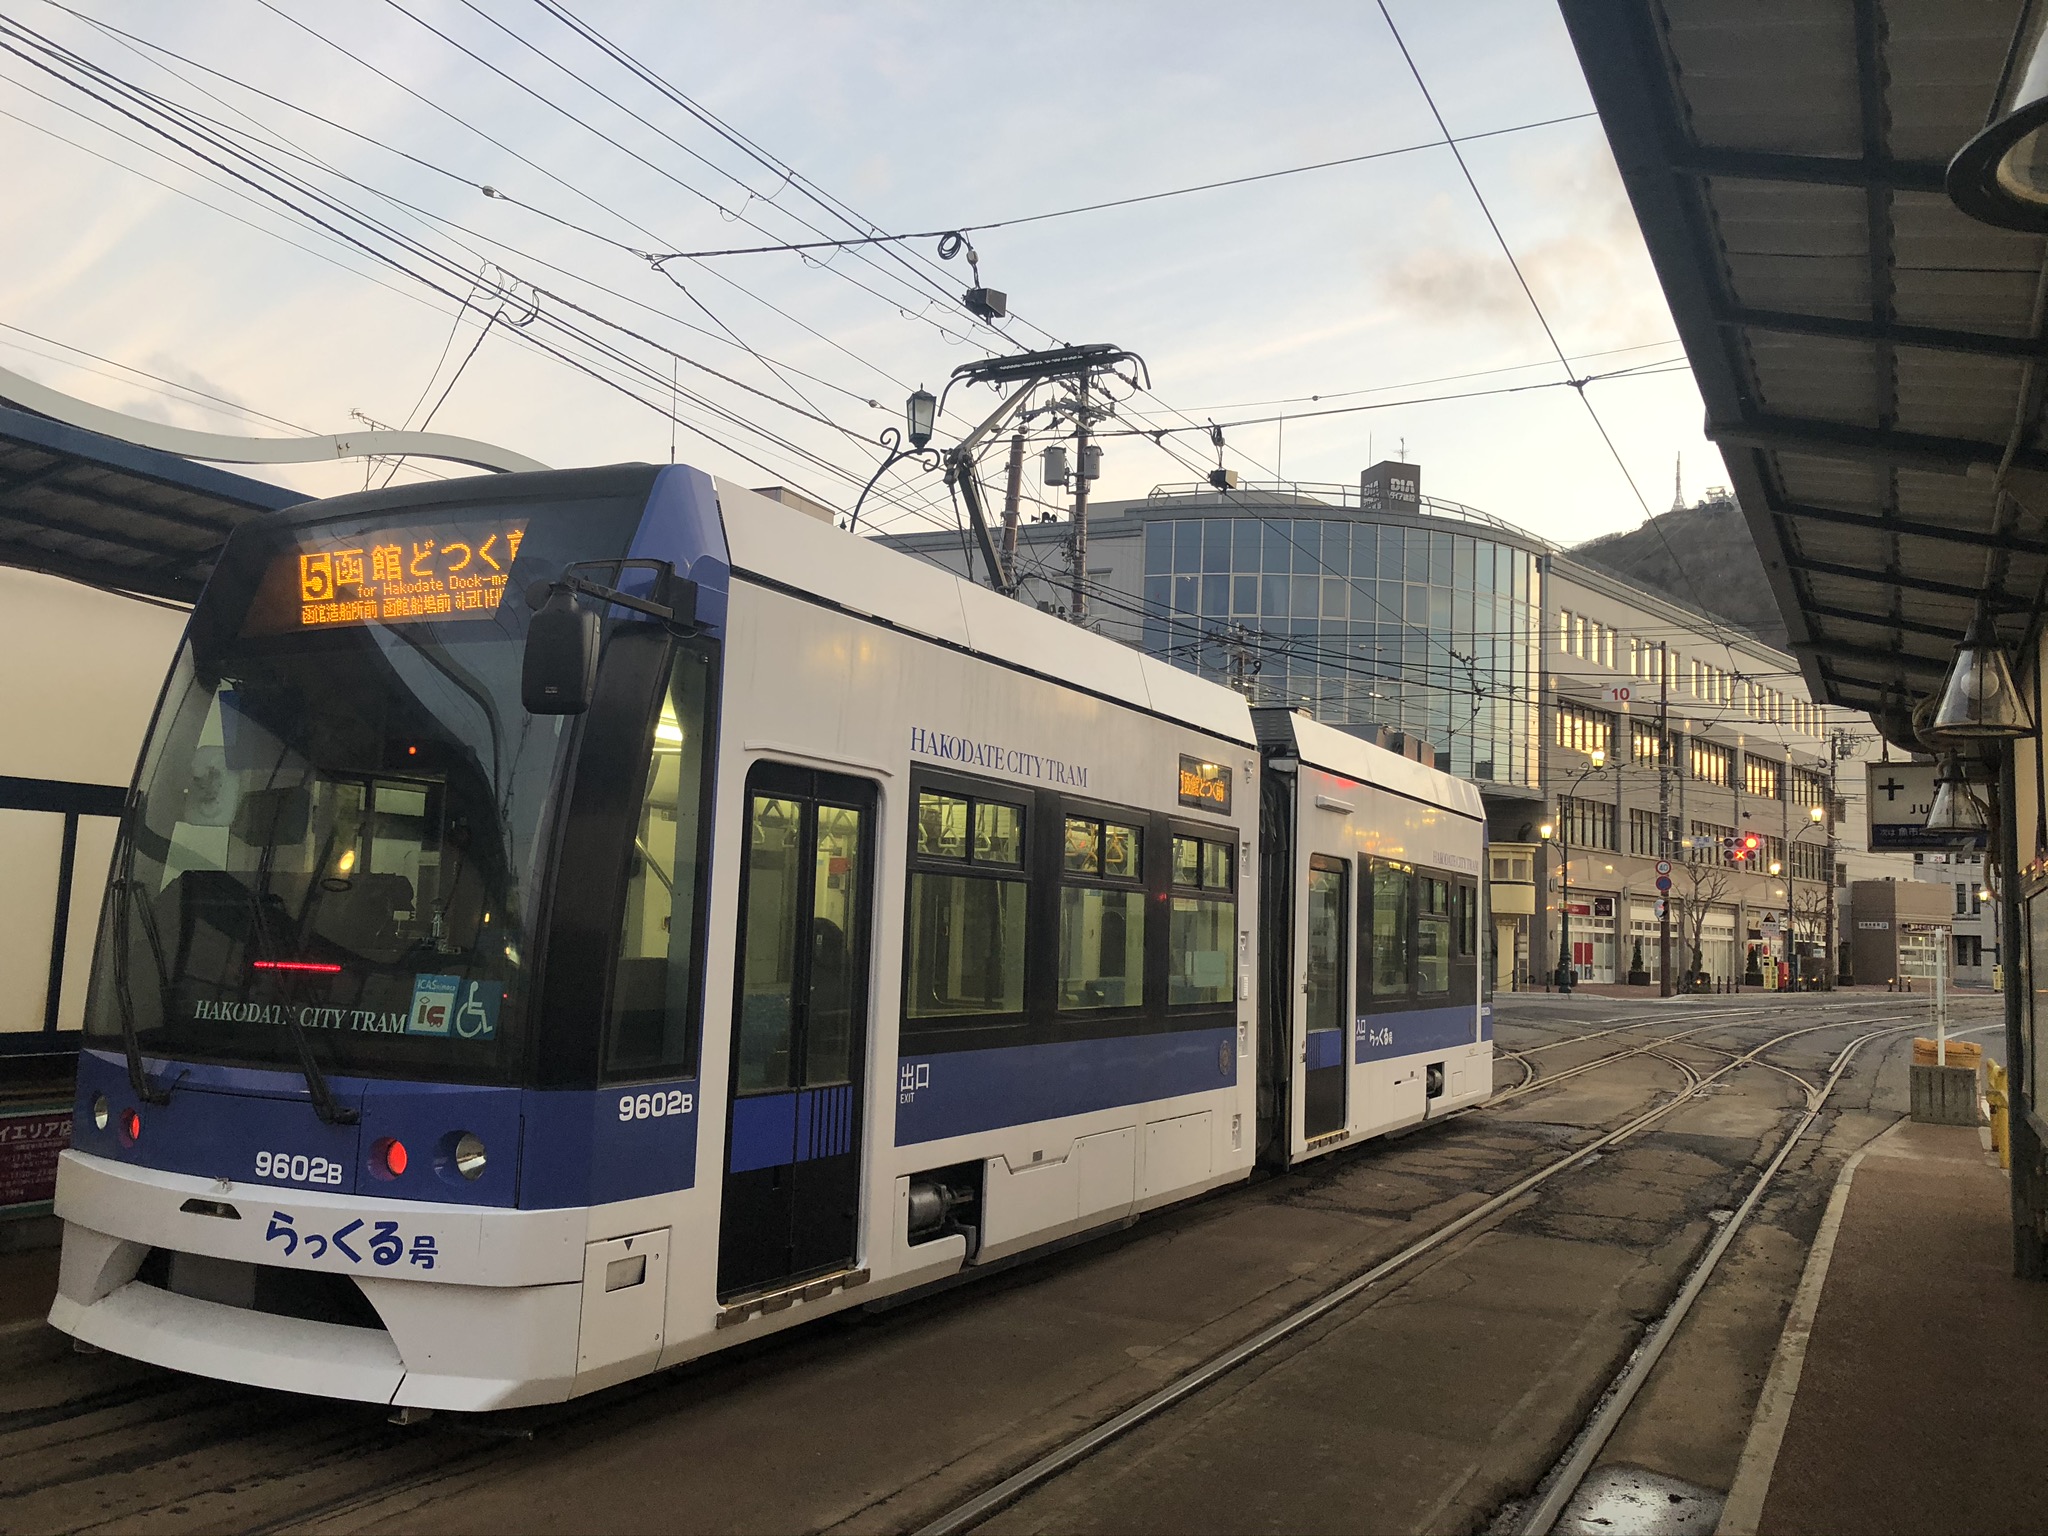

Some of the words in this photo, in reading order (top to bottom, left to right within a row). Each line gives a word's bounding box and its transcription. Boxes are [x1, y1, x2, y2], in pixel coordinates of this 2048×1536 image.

[1390, 477, 1415, 493] DIA
[303, 554, 331, 599] 5
[357, 584, 377, 598] for
[383, 579, 443, 596] Hakodate
[1611, 687, 1630, 701] 10
[910, 726, 1005, 771] HAKODATE
[1006, 750, 1045, 779] CITY
[1045, 758, 1088, 788] TRAM
[1658, 863, 1669, 872] 40
[300, 1006, 347, 1029] CITY
[350, 1010, 408, 1034] TRAM
[1356, 1019, 1366, 1035] 入口
[900, 1063, 930, 1092] 出口
[619, 1090, 693, 1122] 9602B
[900, 1092, 915, 1104] EXIT
[255, 1151, 343, 1185] 9602B
[265, 1210, 439, 1270] らっくる号
